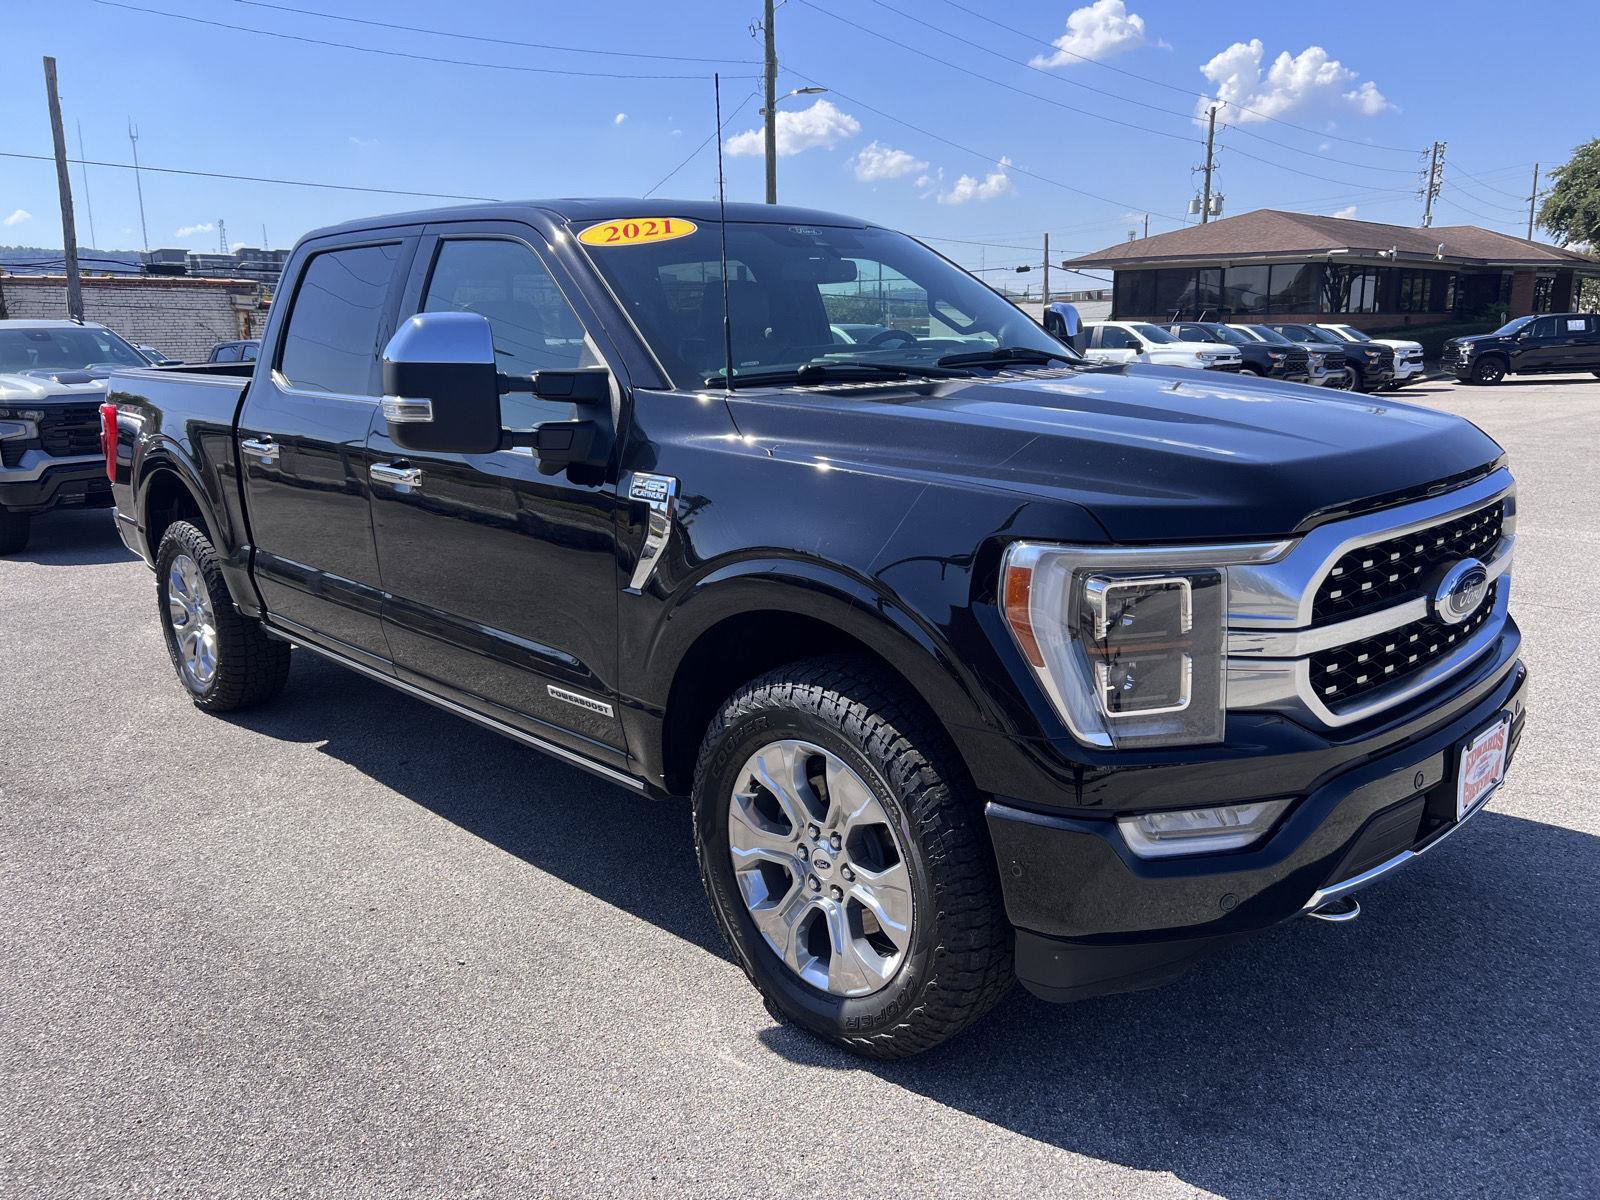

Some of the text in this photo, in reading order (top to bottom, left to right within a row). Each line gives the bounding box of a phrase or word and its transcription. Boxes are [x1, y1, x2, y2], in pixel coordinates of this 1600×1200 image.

[603, 218, 673, 243] 2021
[1459, 577, 1481, 607] Ford
[549, 688, 609, 714] POWERBOOST
[845, 975, 916, 1030] COOPER
